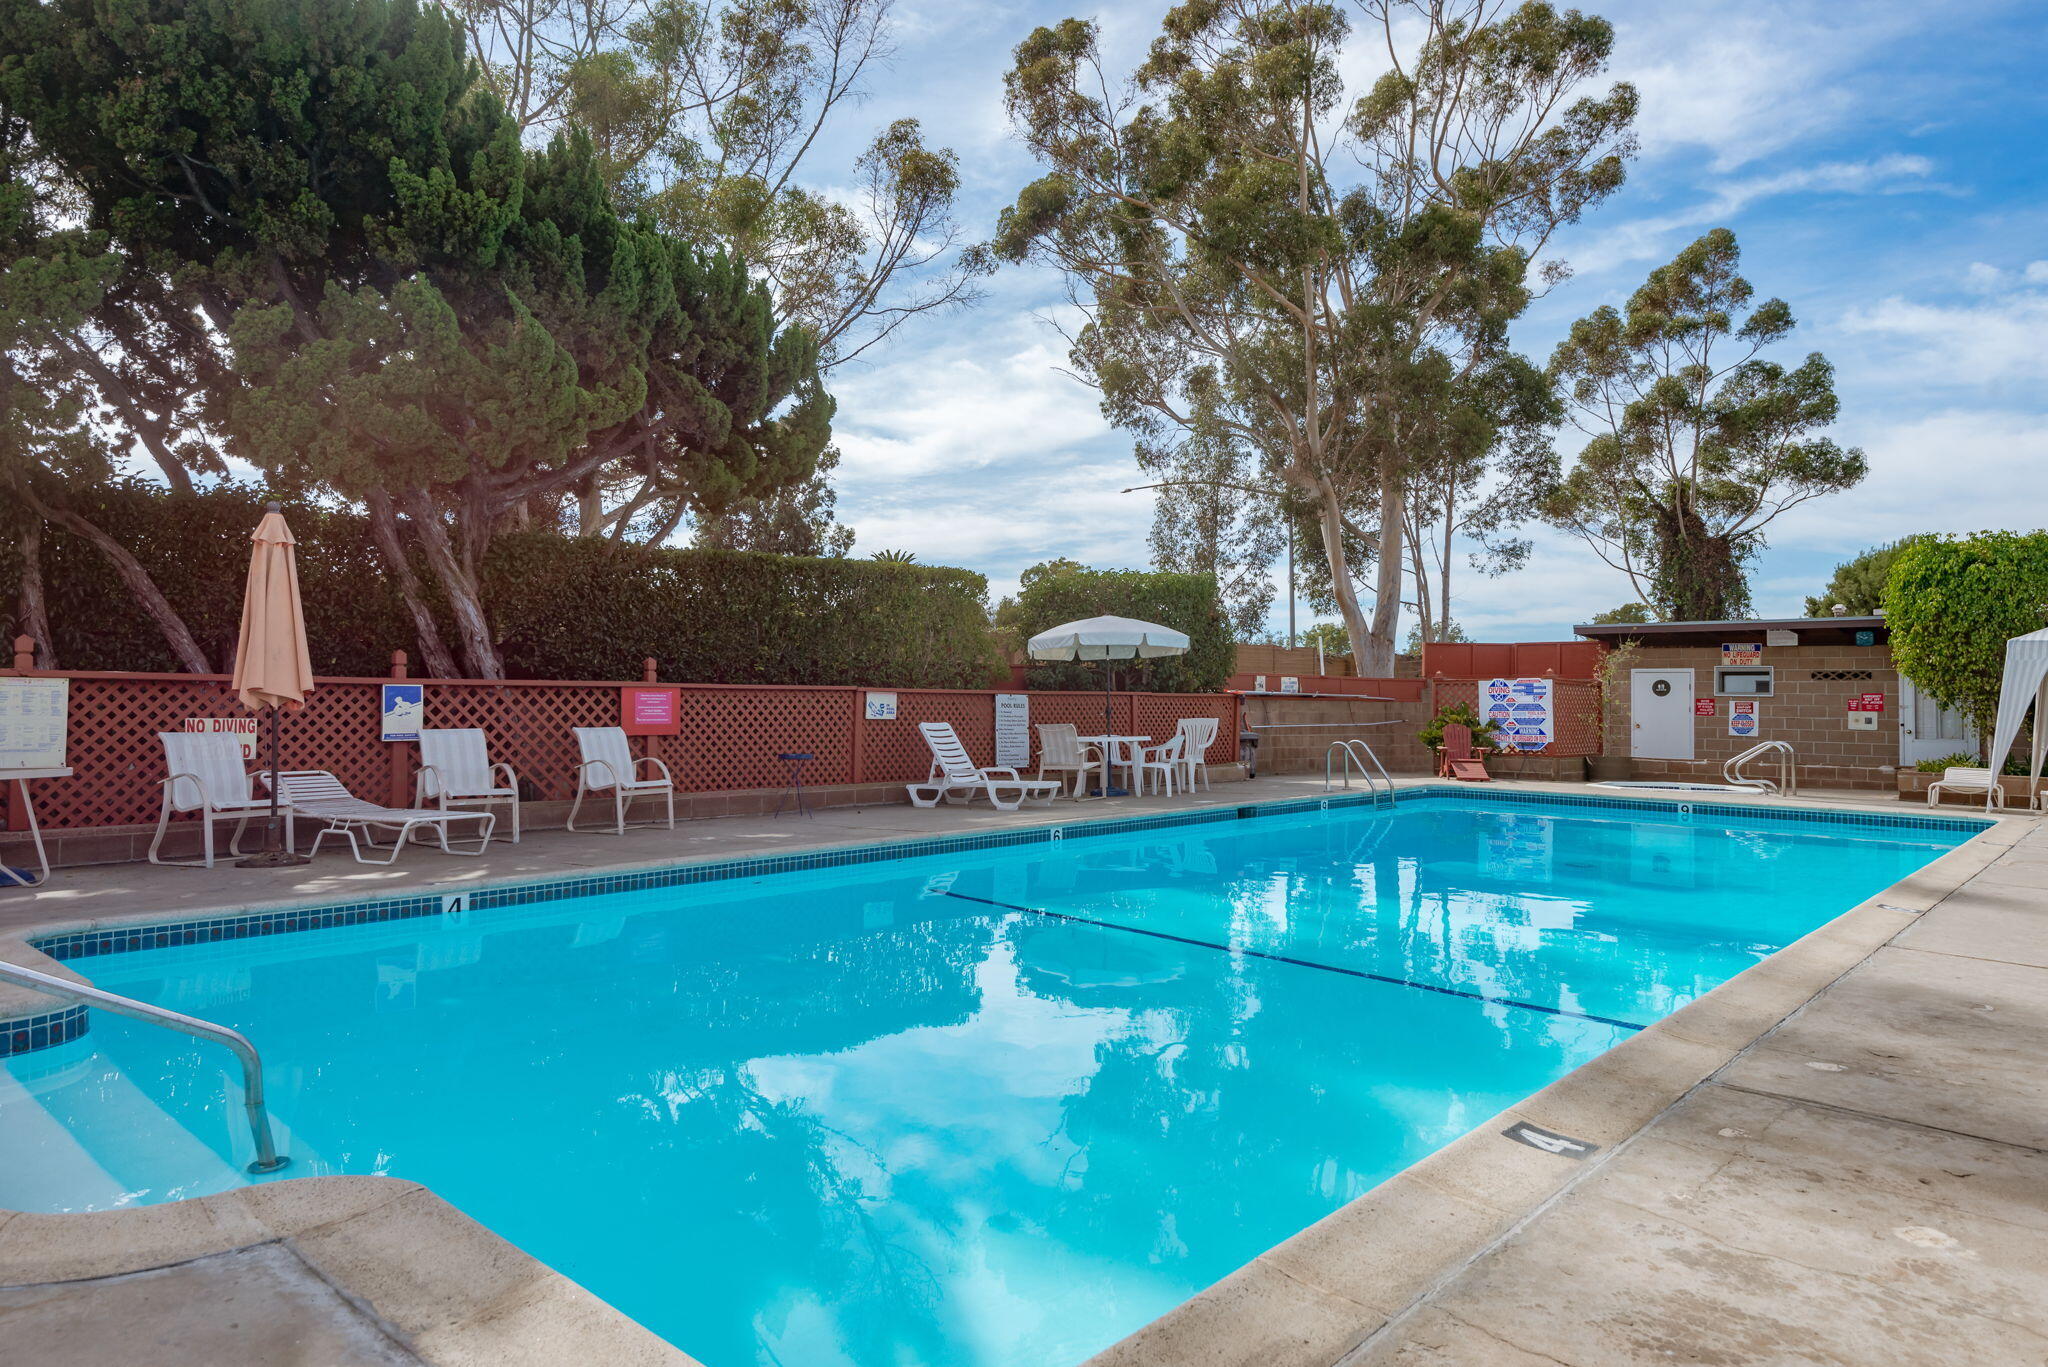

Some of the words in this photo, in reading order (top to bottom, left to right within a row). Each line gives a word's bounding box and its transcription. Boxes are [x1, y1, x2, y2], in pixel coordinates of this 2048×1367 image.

[186, 719, 205, 733] NO
[213, 719, 255, 734] DIVING
[1520, 727, 1540, 735] WARNING
[1519, 1128, 1586, 1153] 4
